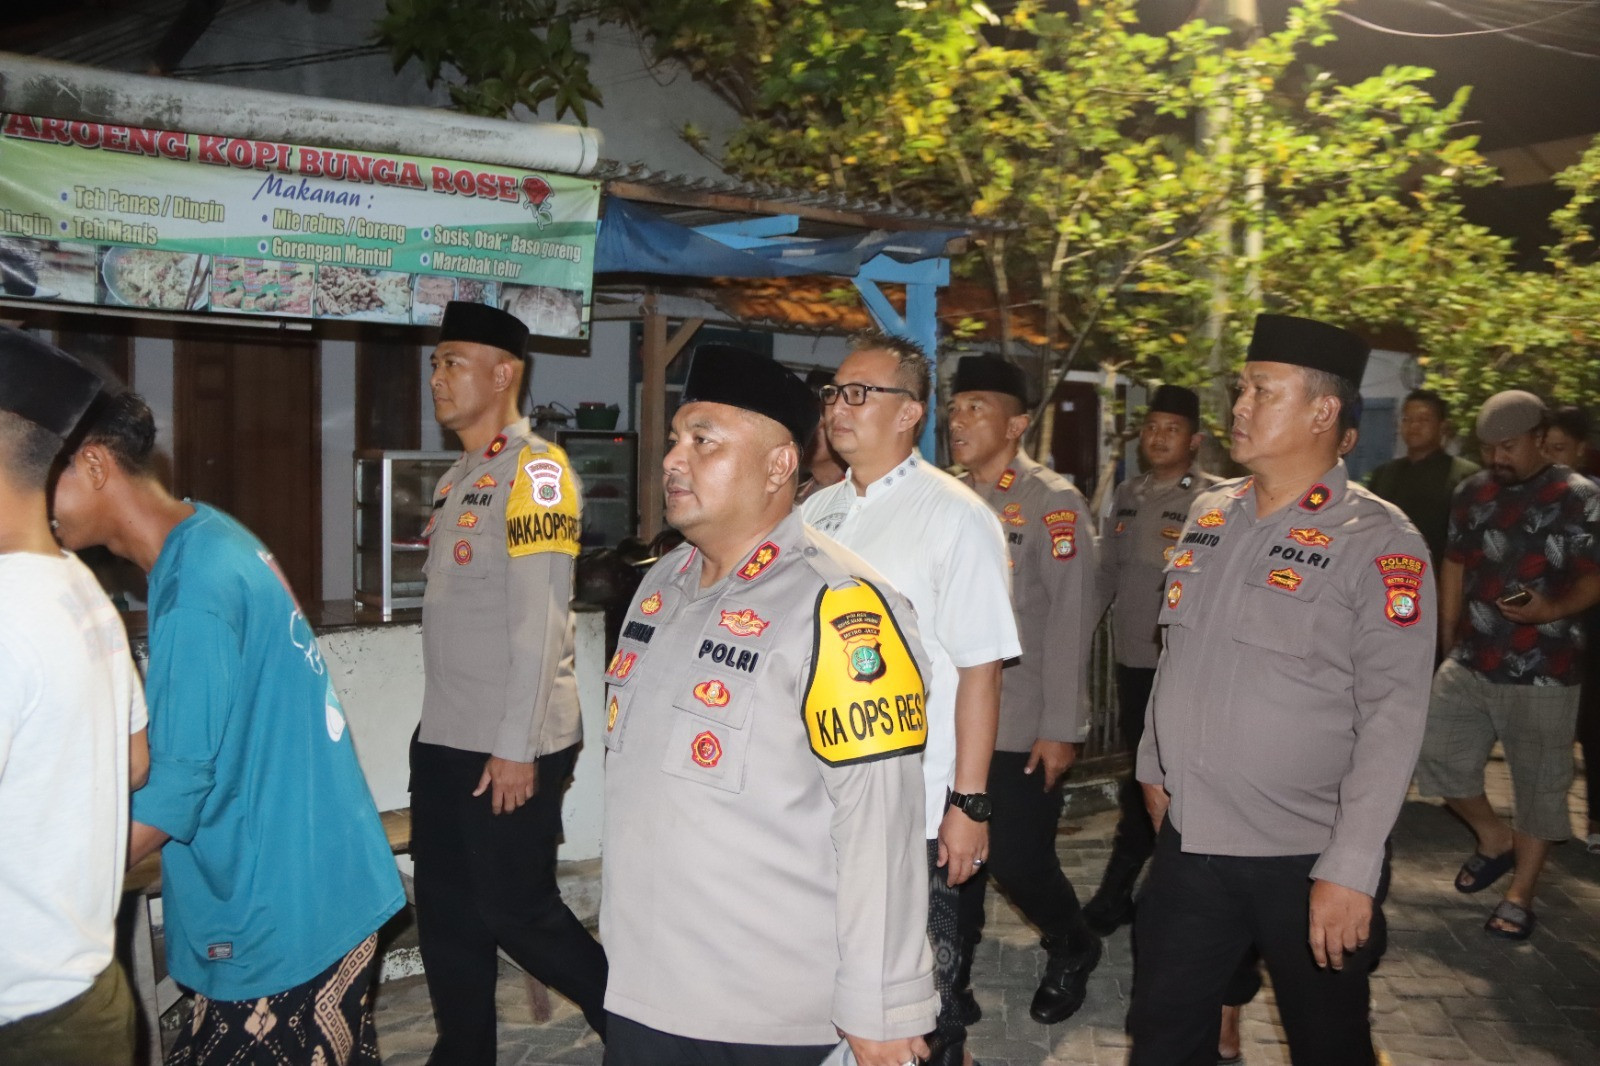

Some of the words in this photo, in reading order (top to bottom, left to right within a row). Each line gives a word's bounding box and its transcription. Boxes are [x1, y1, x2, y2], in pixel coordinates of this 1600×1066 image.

[197, 134, 293, 175] KOPI
[298, 148, 428, 191] BUNGA
[431, 165, 521, 203] ROSE
[74, 185, 106, 211] Teh
[108, 189, 160, 217] Panas
[173, 200, 225, 223] Dingin
[252, 172, 362, 208] Makanan
[73, 216, 105, 241] Teh
[107, 219, 159, 246] Manis
[273, 208, 301, 231] Mie
[302, 213, 345, 236] rebus
[356, 218, 406, 244] Goreng
[271, 237, 342, 264] Gorengan
[344, 243, 393, 268] Mantul
[510, 234, 540, 256] Baso
[540, 241, 582, 263] goreng
[432, 252, 491, 275] Martabak
[492, 258, 523, 278] telur
[461, 493, 493, 507] POLRI
[1268, 545, 1331, 570] POLRI
[1380, 557, 1422, 571] POLRES
[698, 639, 759, 674] POLRI
[815, 706, 849, 748] KA
[848, 697, 895, 741] OPS
[894, 692, 924, 733] RES
